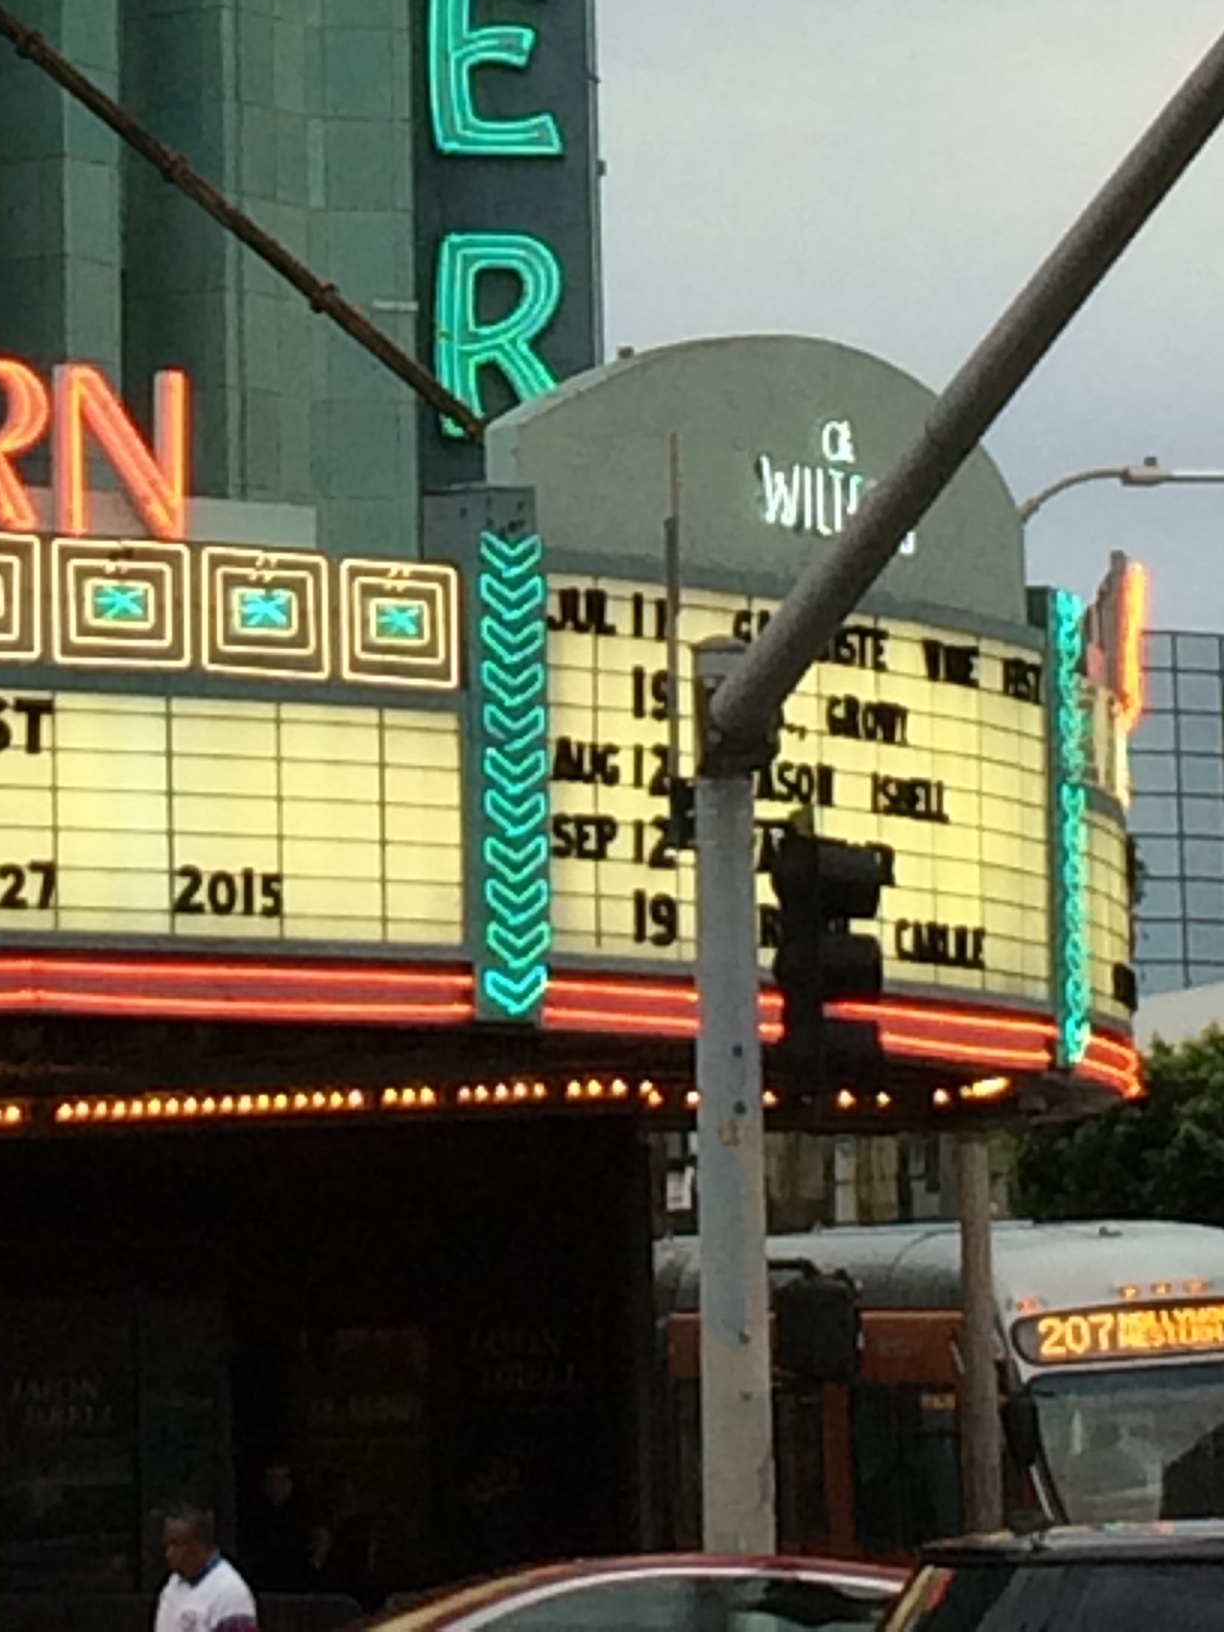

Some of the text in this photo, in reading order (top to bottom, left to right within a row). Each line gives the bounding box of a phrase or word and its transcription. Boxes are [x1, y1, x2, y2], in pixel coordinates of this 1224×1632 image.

[547, 588, 616, 636] JUL
[552, 736, 620, 786] AUG
[552, 813, 677, 868] SEP 12
[173, 865, 285, 917] 2015
[633, 888, 678, 947] 19
[1038, 1313, 1115, 1355] 207
